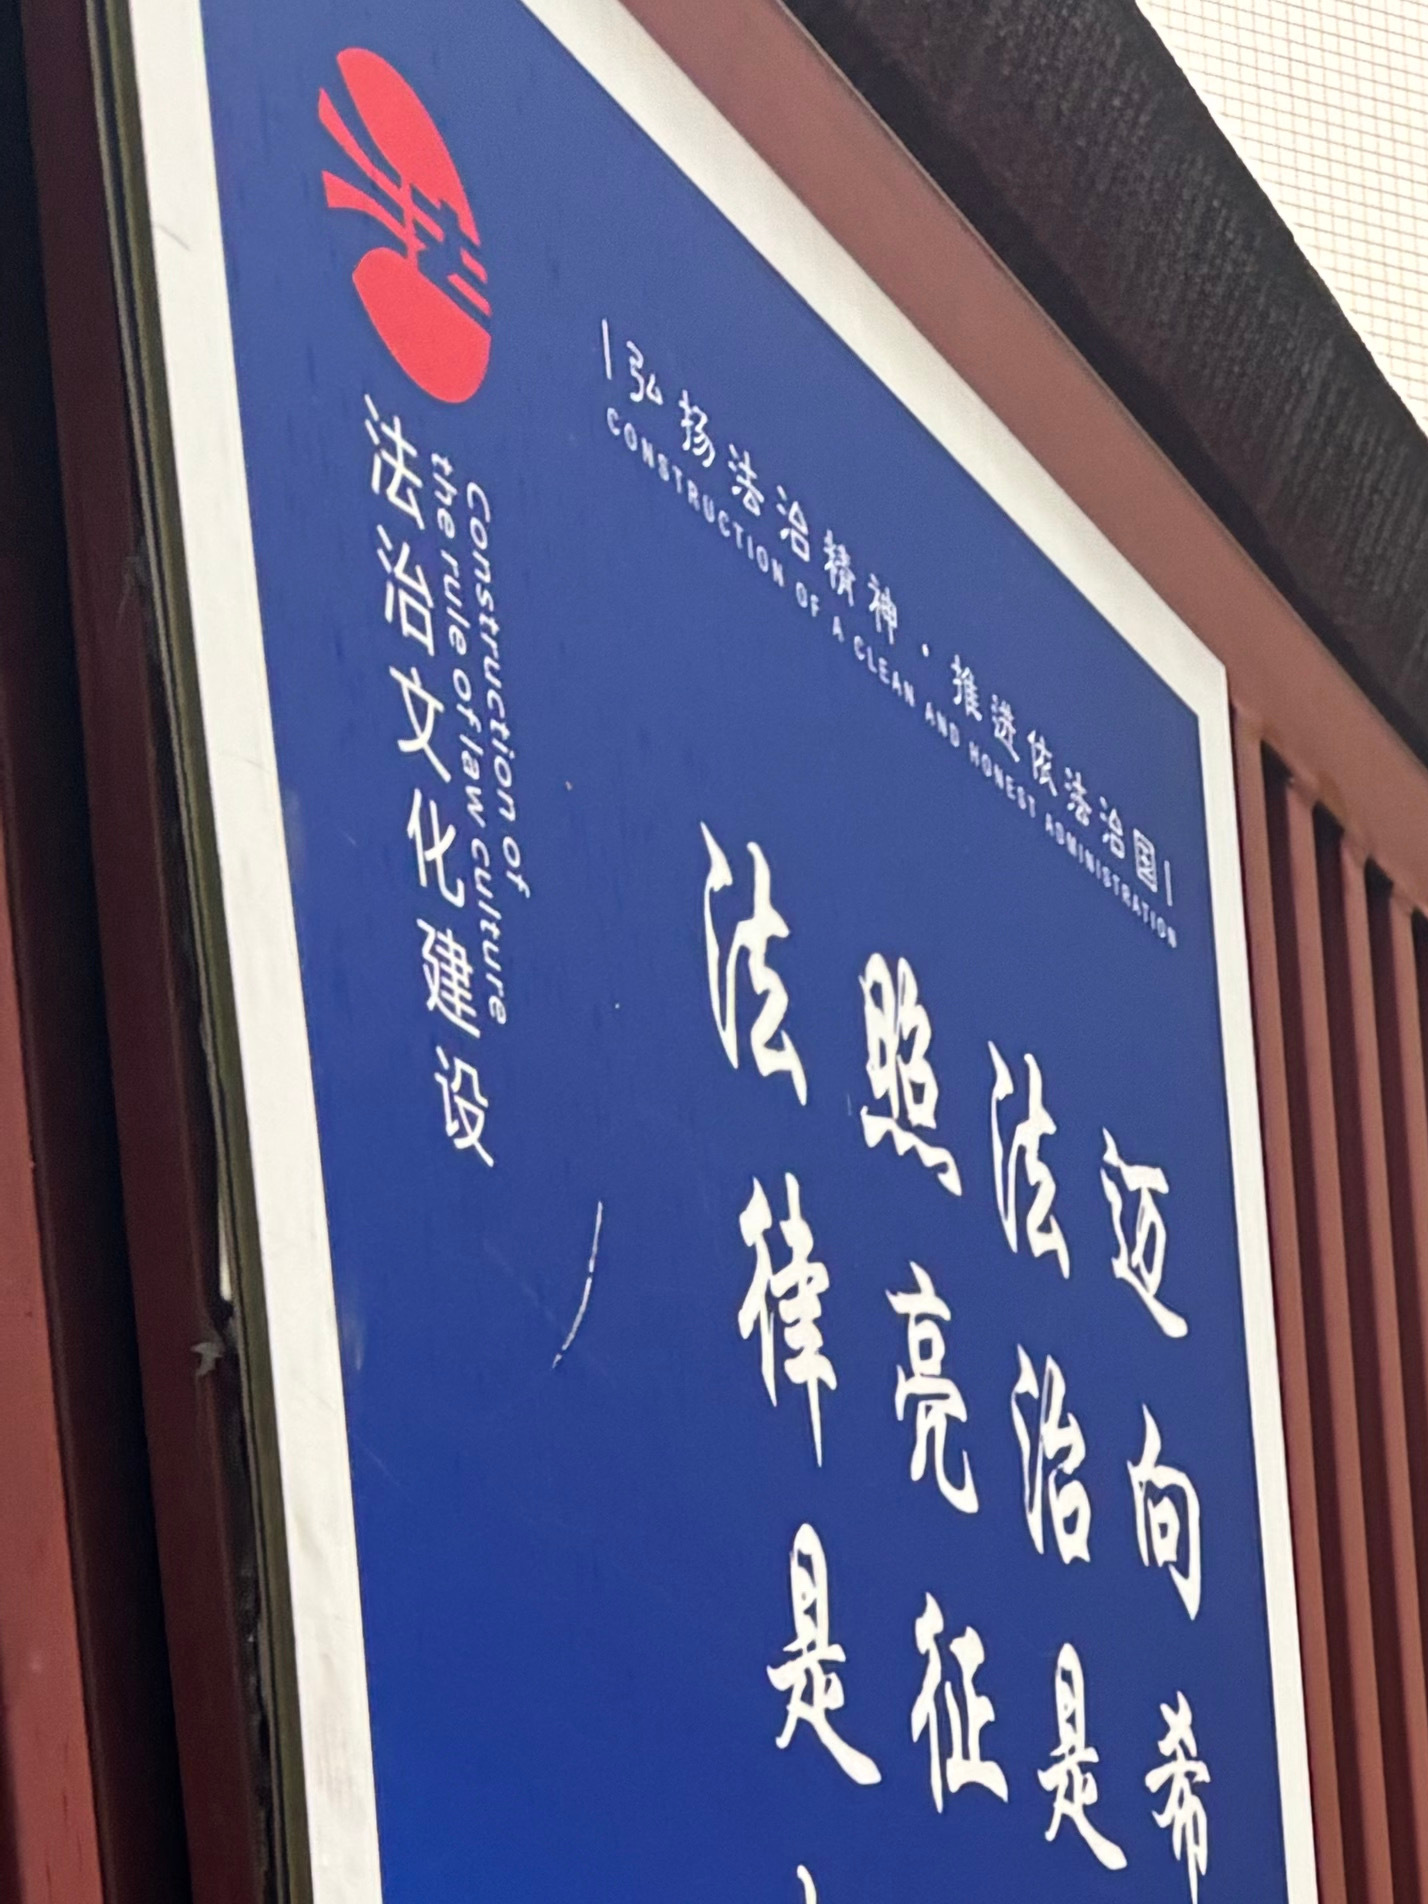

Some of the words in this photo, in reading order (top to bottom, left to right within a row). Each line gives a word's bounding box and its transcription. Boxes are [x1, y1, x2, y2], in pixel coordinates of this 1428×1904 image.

[430, 452, 459, 539] the
[440, 549, 472, 656] rule
[466, 481, 517, 822] Construction
[502, 835, 531, 900] of
[606, 406, 785, 588] CONSTRUCTION
[795, 581, 820, 618] OF
[832, 615, 845, 643] A
[853, 634, 916, 708] CLEAN
[924, 701, 961, 748] AND
[969, 741, 1037, 819] HONEST
[1044, 812, 1178, 949] ADMINISTRATION
[625, 339, 1158, 893] 弘扬法治精神·推进依法治国
[363, 393, 496, 1168] 法治文化建设
[452, 668, 482, 734] of
[459, 733, 488, 828] law
[471, 837, 508, 1025] culture
